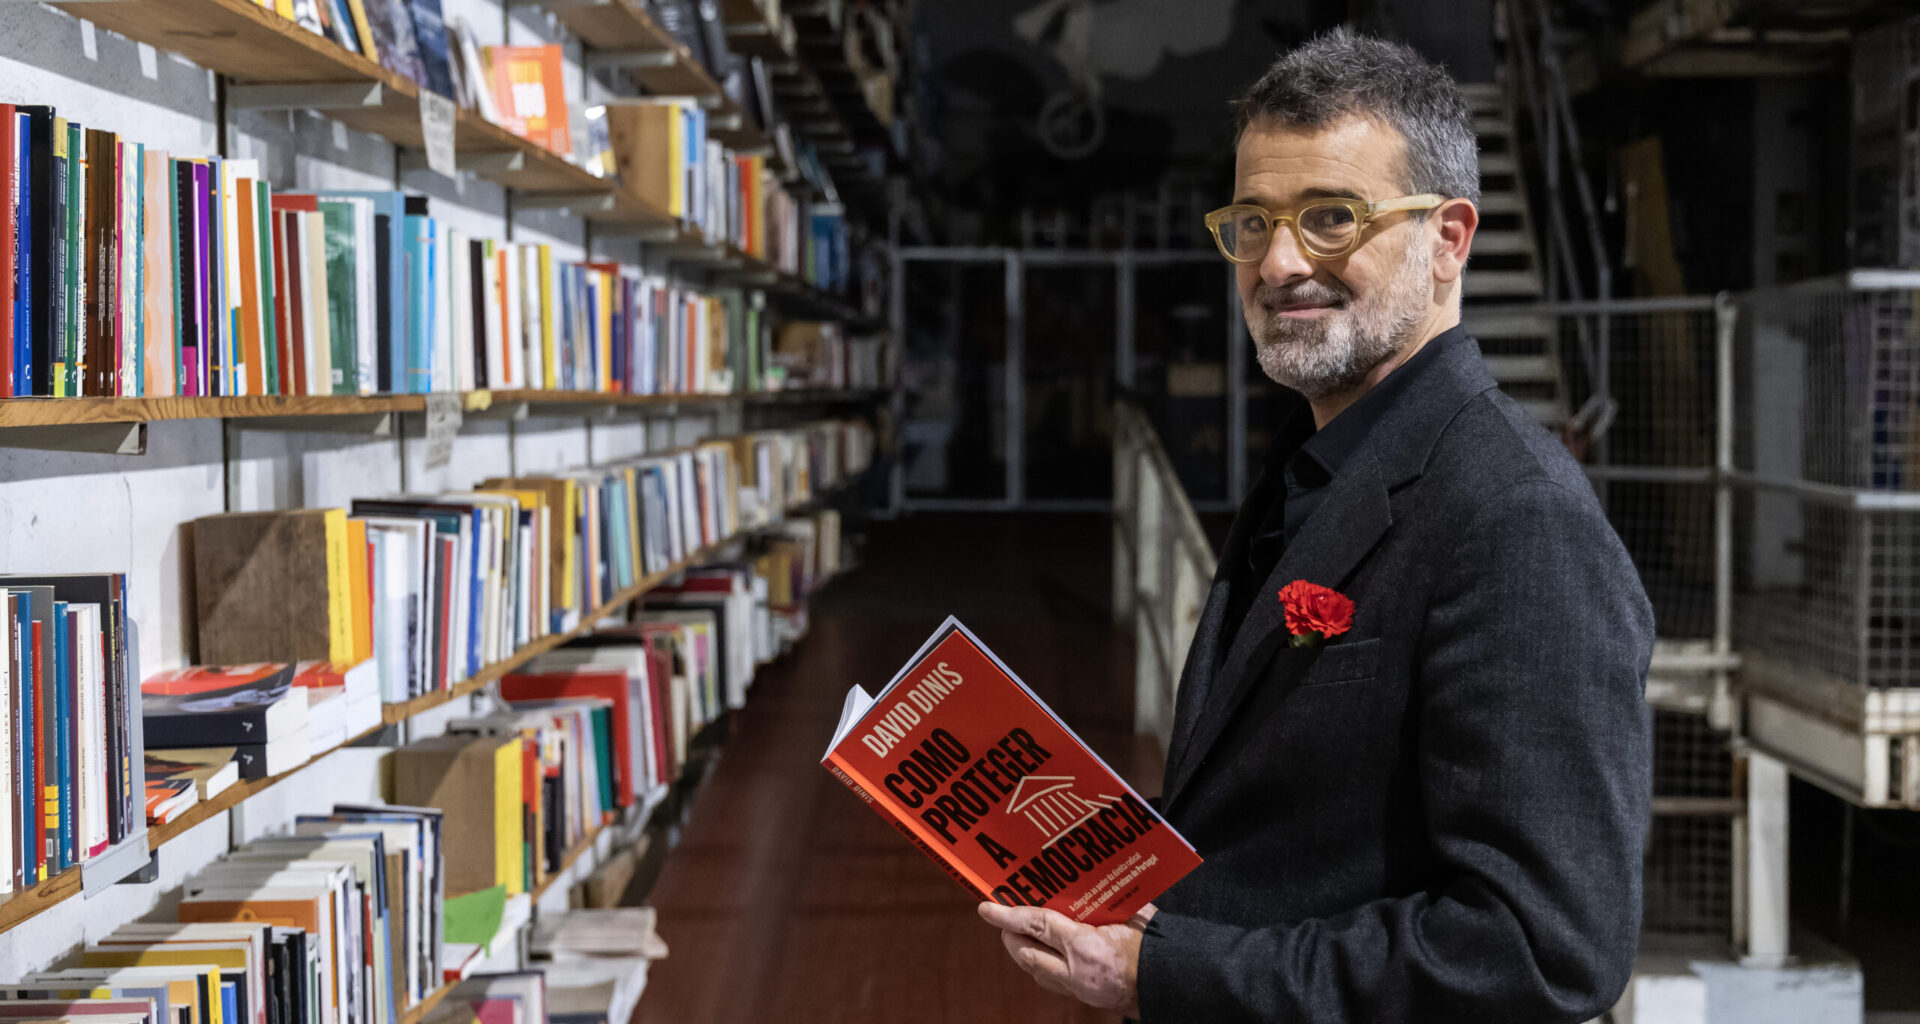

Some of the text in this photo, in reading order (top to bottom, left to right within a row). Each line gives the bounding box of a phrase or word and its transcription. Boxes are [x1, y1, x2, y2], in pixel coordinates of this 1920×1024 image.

[861, 662, 964, 758] DAVID DINIS
[832, 766, 875, 804] DAVID DINIS
[884, 728, 971, 810] COMO
[921, 728, 1052, 845] PROTEGER
[895, 821, 917, 841] COMO
[917, 839, 953, 873] PROTEGER
[974, 830, 1016, 870] A
[991, 791, 1162, 908] DEMOCRACIA
[1069, 904, 1076, 912] A
[1073, 891, 1092, 910] chegada
[1091, 887, 1098, 895] ao
[1096, 877, 1109, 891] poder
[1112, 863, 1128, 877] direita
[1126, 851, 1142, 867] radical
[1077, 905, 1095, 921] desafio
[1098, 889, 1114, 904] cuidar
[1116, 873, 1133, 888] futuro
[1135, 853, 1159, 873] Portugal
